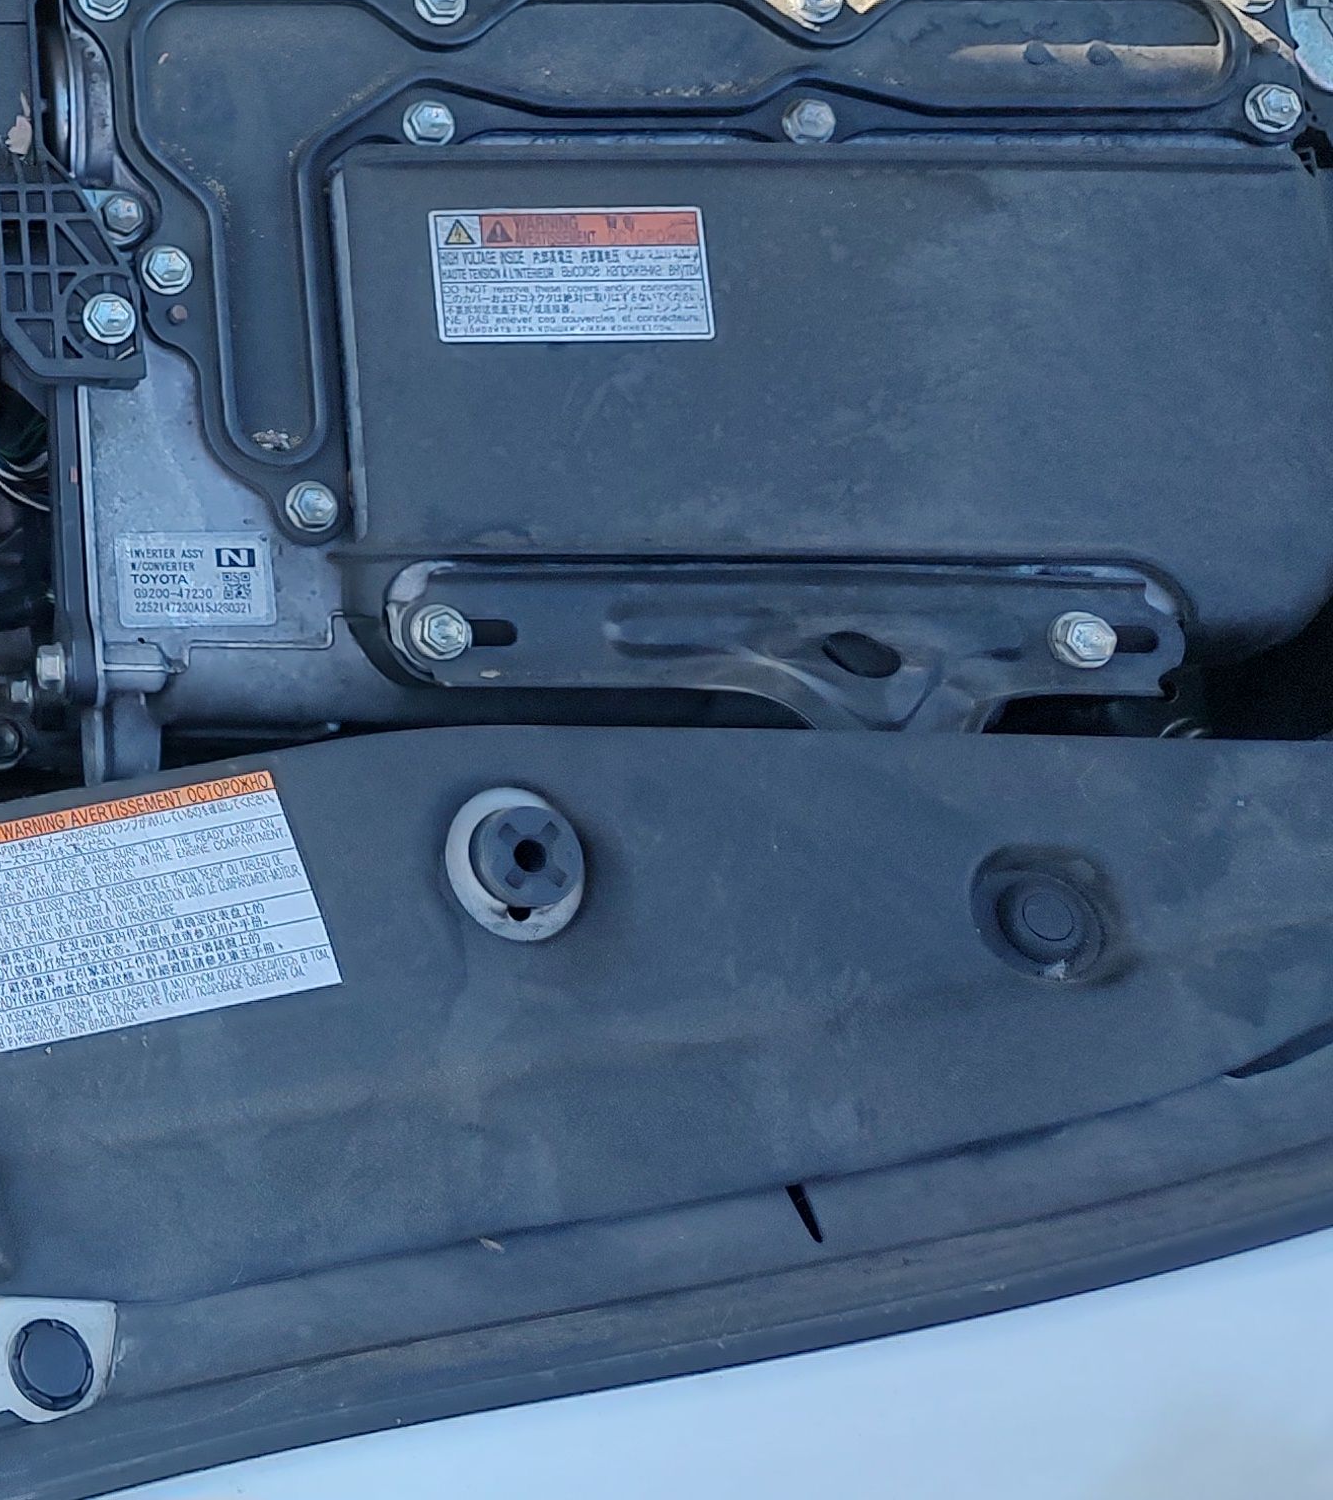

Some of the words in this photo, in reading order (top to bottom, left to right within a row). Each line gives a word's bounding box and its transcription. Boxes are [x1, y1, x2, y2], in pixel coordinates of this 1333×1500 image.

[442, 285, 458, 295] DO
[464, 284, 487, 294] NOT
[492, 284, 529, 294] remove
[445, 315, 461, 325] NE
[467, 315, 488, 325] PAS
[129, 548, 176, 559] INVERTER
[180, 548, 205, 559] ASSY
[130, 573, 189, 585] TOYOTA
[185, 772, 270, 803] ОСТОРОЖНО
[0, 813, 66, 840] WARNING
[68, 790, 184, 826] AVERTISSEMENT
[43, 856, 78, 873] PLEASE
[82, 850, 110, 866] MAKE
[111, 845, 138, 860] SURE
[142, 839, 167, 854] THAT
[193, 827, 226, 843] READY
[258, 817, 275, 830] ON
[14, 879, 24, 891] IS
[27, 874, 47, 888] OFF
[50, 866, 88, 884] BEFORE
[90, 857, 136, 876] WORKING
[138, 854, 150, 866] IN
[152, 850, 172, 863] THE
[175, 842, 210, 859] ENGINE
[26, 882, 65, 899] MANUAL
[70, 877, 91, 891] FOR
